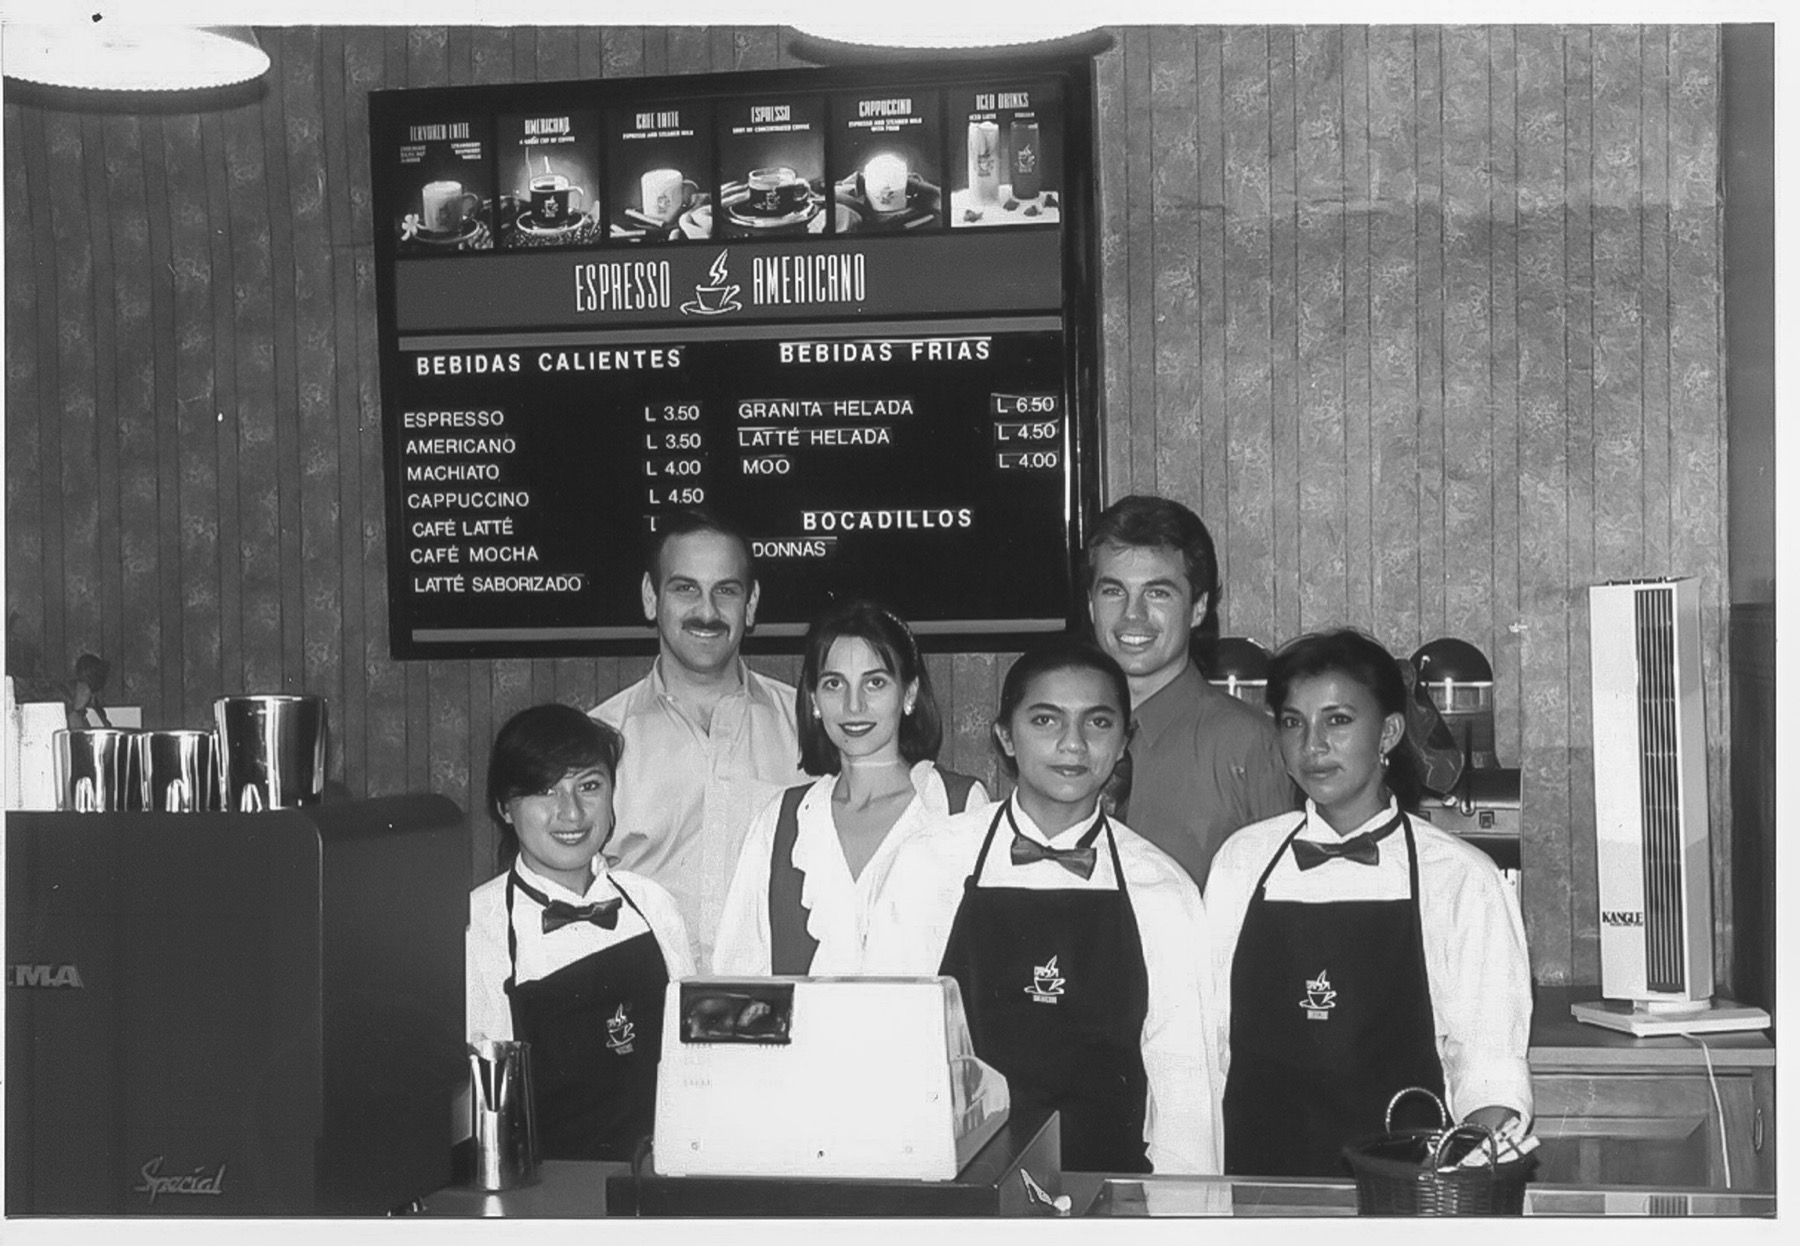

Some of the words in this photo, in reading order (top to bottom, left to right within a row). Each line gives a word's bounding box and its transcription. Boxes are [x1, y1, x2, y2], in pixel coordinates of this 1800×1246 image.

[859, 98, 912, 117] CAPPUCCINO
[998, 91, 1029, 109] DRINKS
[525, 117, 570, 135] AMERICANO
[575, 261, 670, 312] ESPRESSO
[753, 253, 865, 304] AMERICANO
[417, 353, 521, 376] BEBIDAS
[538, 349, 681, 372] CALIENTES
[780, 342, 892, 363] BEBIDAS
[911, 341, 990, 360] FRIAS
[404, 410, 504, 428] ESPRESSO
[645, 406, 656, 422] L
[664, 405, 700, 421] 3.50
[738, 401, 822, 418] GRANITA
[834, 400, 913, 416] HELADA
[997, 398, 1008, 413] L
[1016, 397, 1055, 413] 6.50
[406, 438, 516, 455] AMERICANO
[646, 434, 658, 449] L
[665, 433, 701, 449] 3.50
[738, 427, 800, 447] LATTÉ
[810, 428, 890, 445] HELADA
[998, 425, 1009, 440] L
[1018, 423, 1056, 439] 4.50
[407, 464, 500, 481] MACHIATO
[646, 461, 657, 476] L
[664, 460, 701, 476] 4.00
[743, 459, 790, 475] MOO
[999, 454, 1009, 469] L
[1019, 452, 1057, 468] 4.00
[408, 492, 529, 509] CAPPUCCINO
[649, 489, 661, 504] L
[668, 488, 704, 504] 4.50
[412, 518, 456, 537] CAFÉ
[462, 516, 514, 535] LATTÉ
[803, 509, 971, 531] BOCADILLOS
[410, 544, 459, 564] CAFÉ
[469, 546, 539, 563] MOCHA
[752, 541, 826, 557] DONNAS
[414, 573, 464, 592] LATTÉ
[472, 576, 581, 593] SABORIZADO
[135, 1156, 226, 1205] Special
